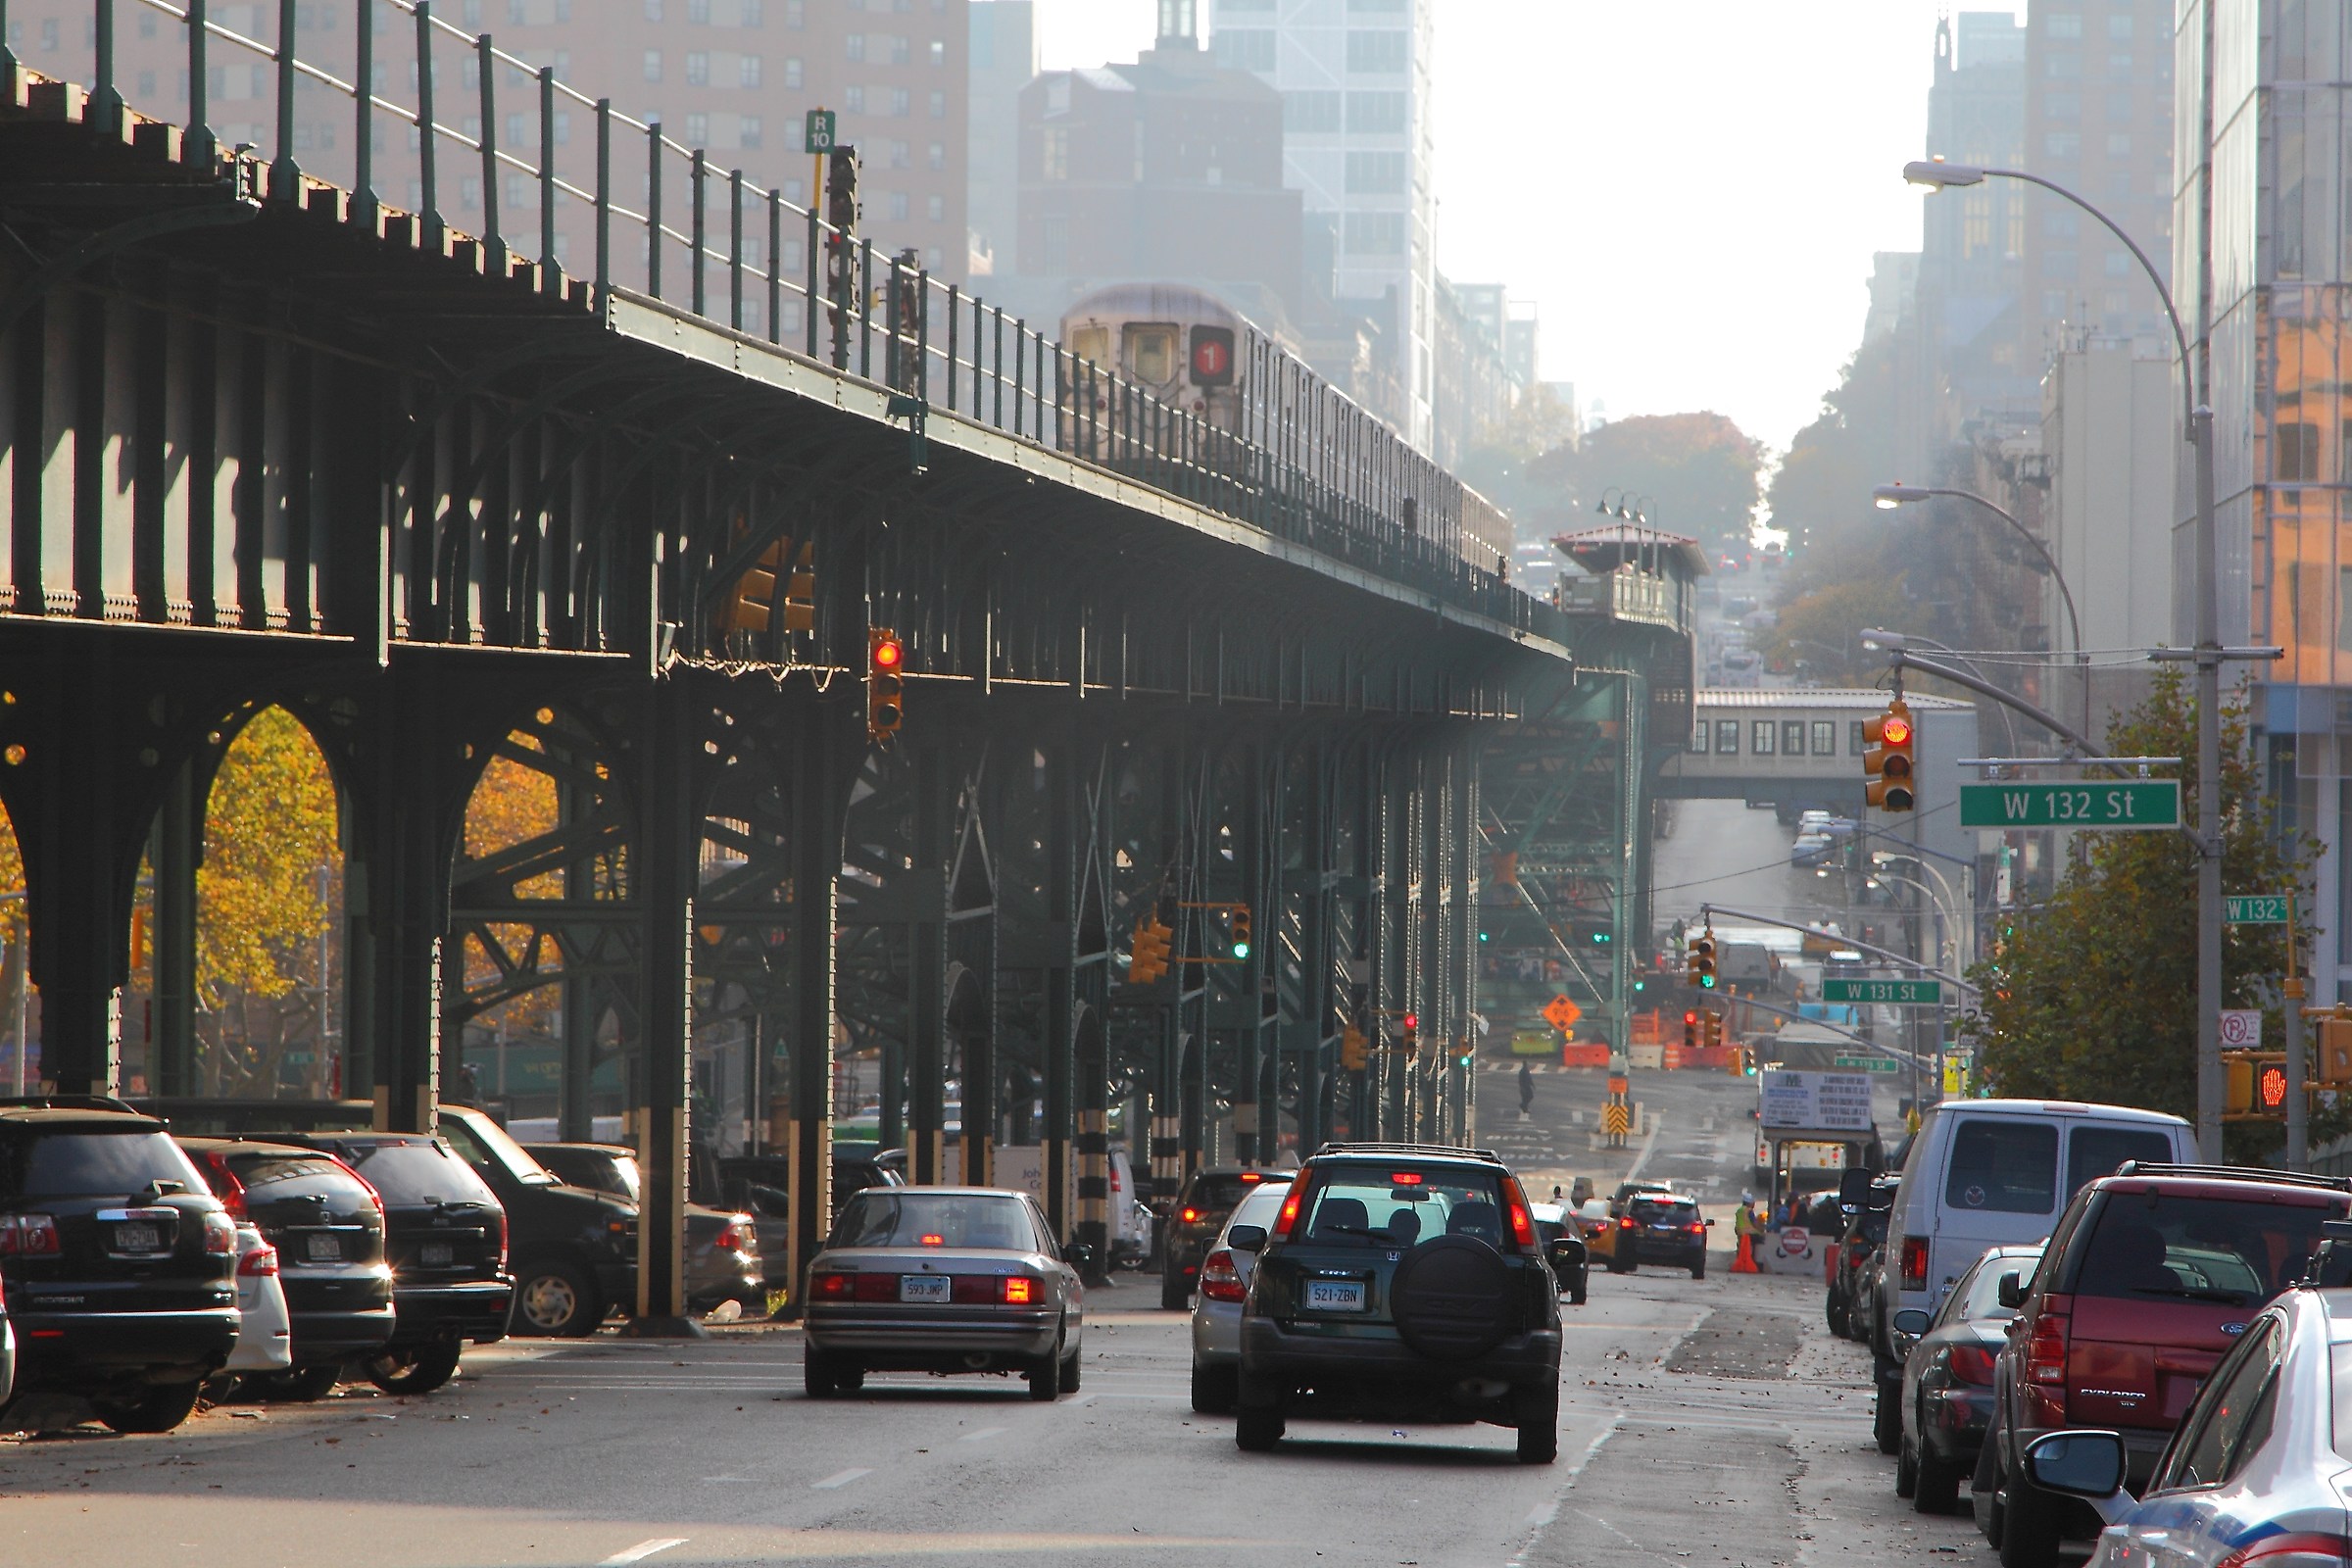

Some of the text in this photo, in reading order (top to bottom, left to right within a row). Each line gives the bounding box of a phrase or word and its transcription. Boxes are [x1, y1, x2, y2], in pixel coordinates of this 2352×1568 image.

[814, 116, 827, 131] R
[811, 131, 830, 147] 10
[1203, 345, 1215, 370] 1
[2004, 791, 2134, 819] W 132 St
[2228, 900, 2242, 919] W
[2247, 900, 2278, 919] 132
[1847, 984, 1916, 1000] W 131 St
